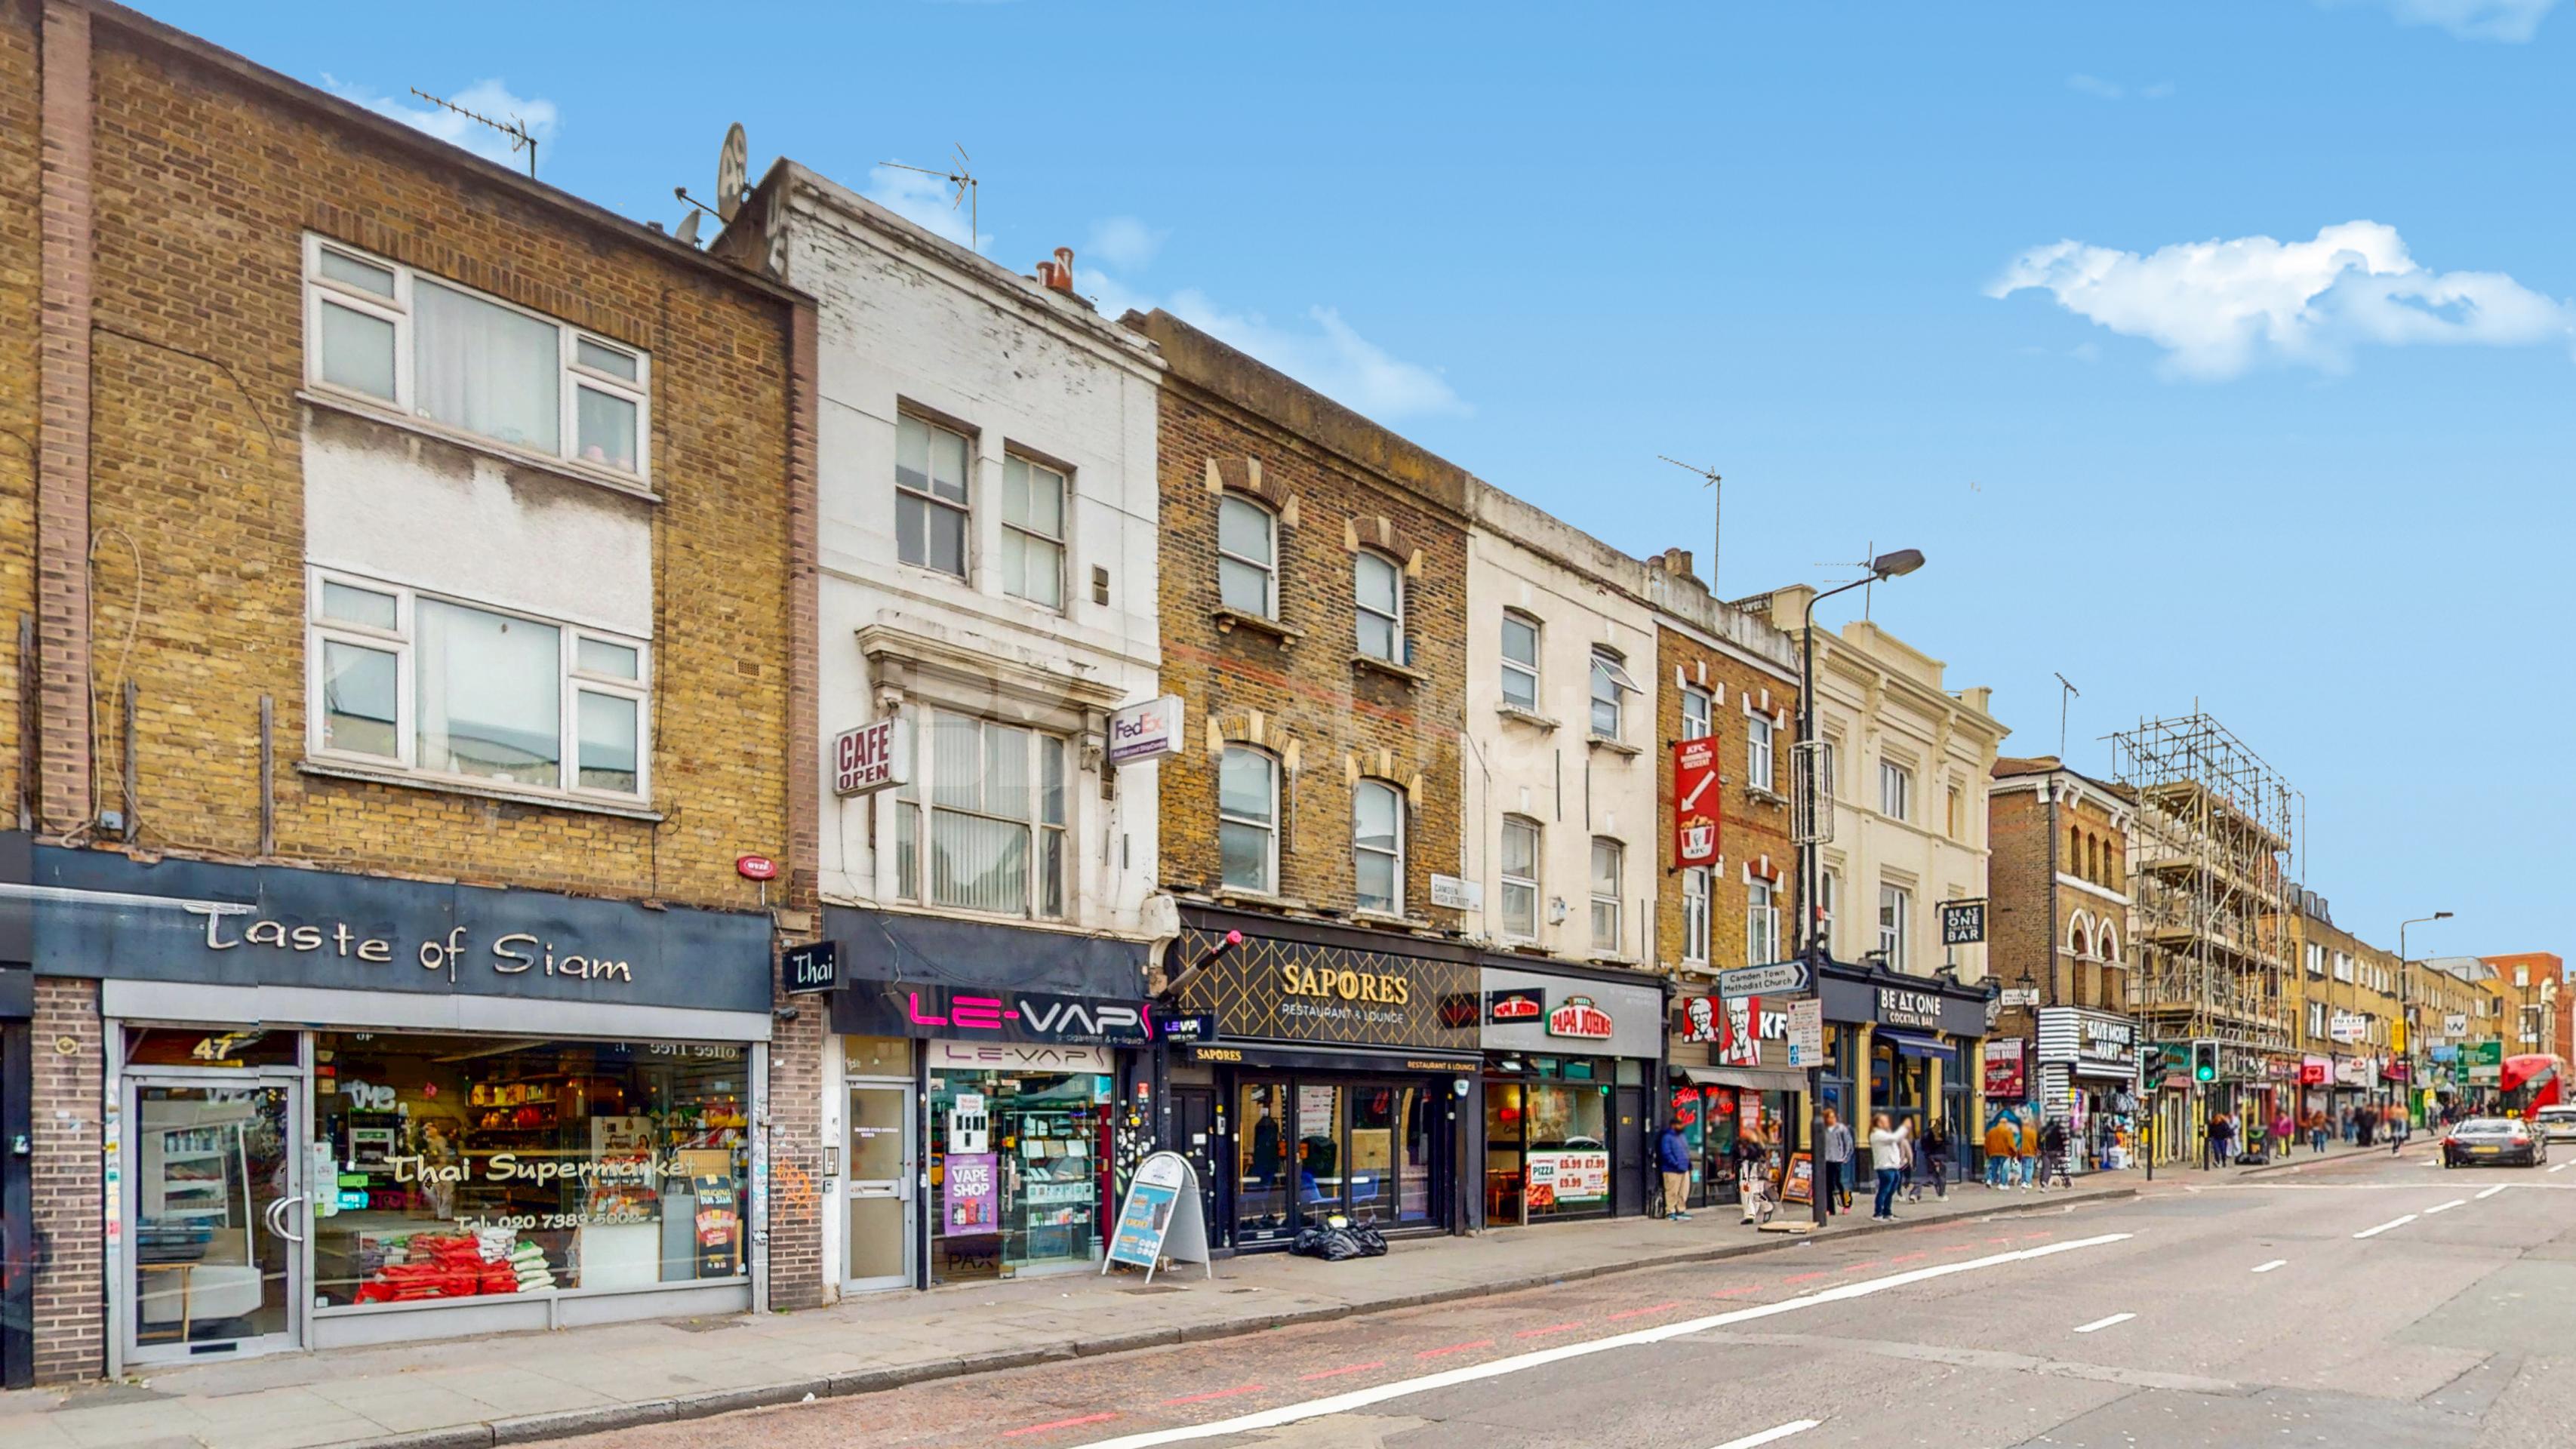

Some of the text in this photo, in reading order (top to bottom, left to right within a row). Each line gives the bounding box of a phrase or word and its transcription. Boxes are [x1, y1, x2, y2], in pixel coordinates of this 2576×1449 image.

[1115, 712, 1163, 740] FedEx
[840, 724, 889, 773] CAFE
[1686, 743, 1707, 755] KFC
[839, 763, 889, 790] OPEN
[1434, 884, 1458, 896] CAMDEN
[1450, 896, 1469, 907] STREET
[1948, 907, 1979, 918] BE AT
[1948, 915, 1979, 927] ONE
[182, 902, 632, 983] Taste of Siam
[1948, 930, 1979, 942] BAR
[792, 953, 834, 985] Thai
[1730, 970, 1786, 983] Camden Town
[1282, 964, 1409, 1005] SAPORES
[1724, 977, 1793, 993] Methodist Church
[1496, 1002, 1538, 1016] PAPA JOHNS
[1881, 989, 1941, 1016] BE AT ONE
[1282, 1004, 1404, 1023] RESTAURANT & LOUNGE
[1552, 1008, 1611, 1035] PAPA JOHNS
[1889, 1011, 1933, 1026] COCKTAIL BAR
[1760, 1011, 1789, 1040] KF
[2088, 1020, 2130, 1044] SAVE MORE
[193, 1037, 232, 1060] 47
[1196, 1048, 1242, 1062] SAPORES
[1408, 1060, 1447, 1070] RESTAURANT
[1452, 1063, 1476, 1072] LOUNGE
[383, 1150, 696, 1187] Thai Supermarket
[952, 1168, 989, 1183] VAPE
[1533, 1166, 1554, 1176] PIZZA
[953, 1183, 990, 1197] SHOP
[497, 1214, 537, 1230] 020
[948, 1251, 994, 1272] PAX
